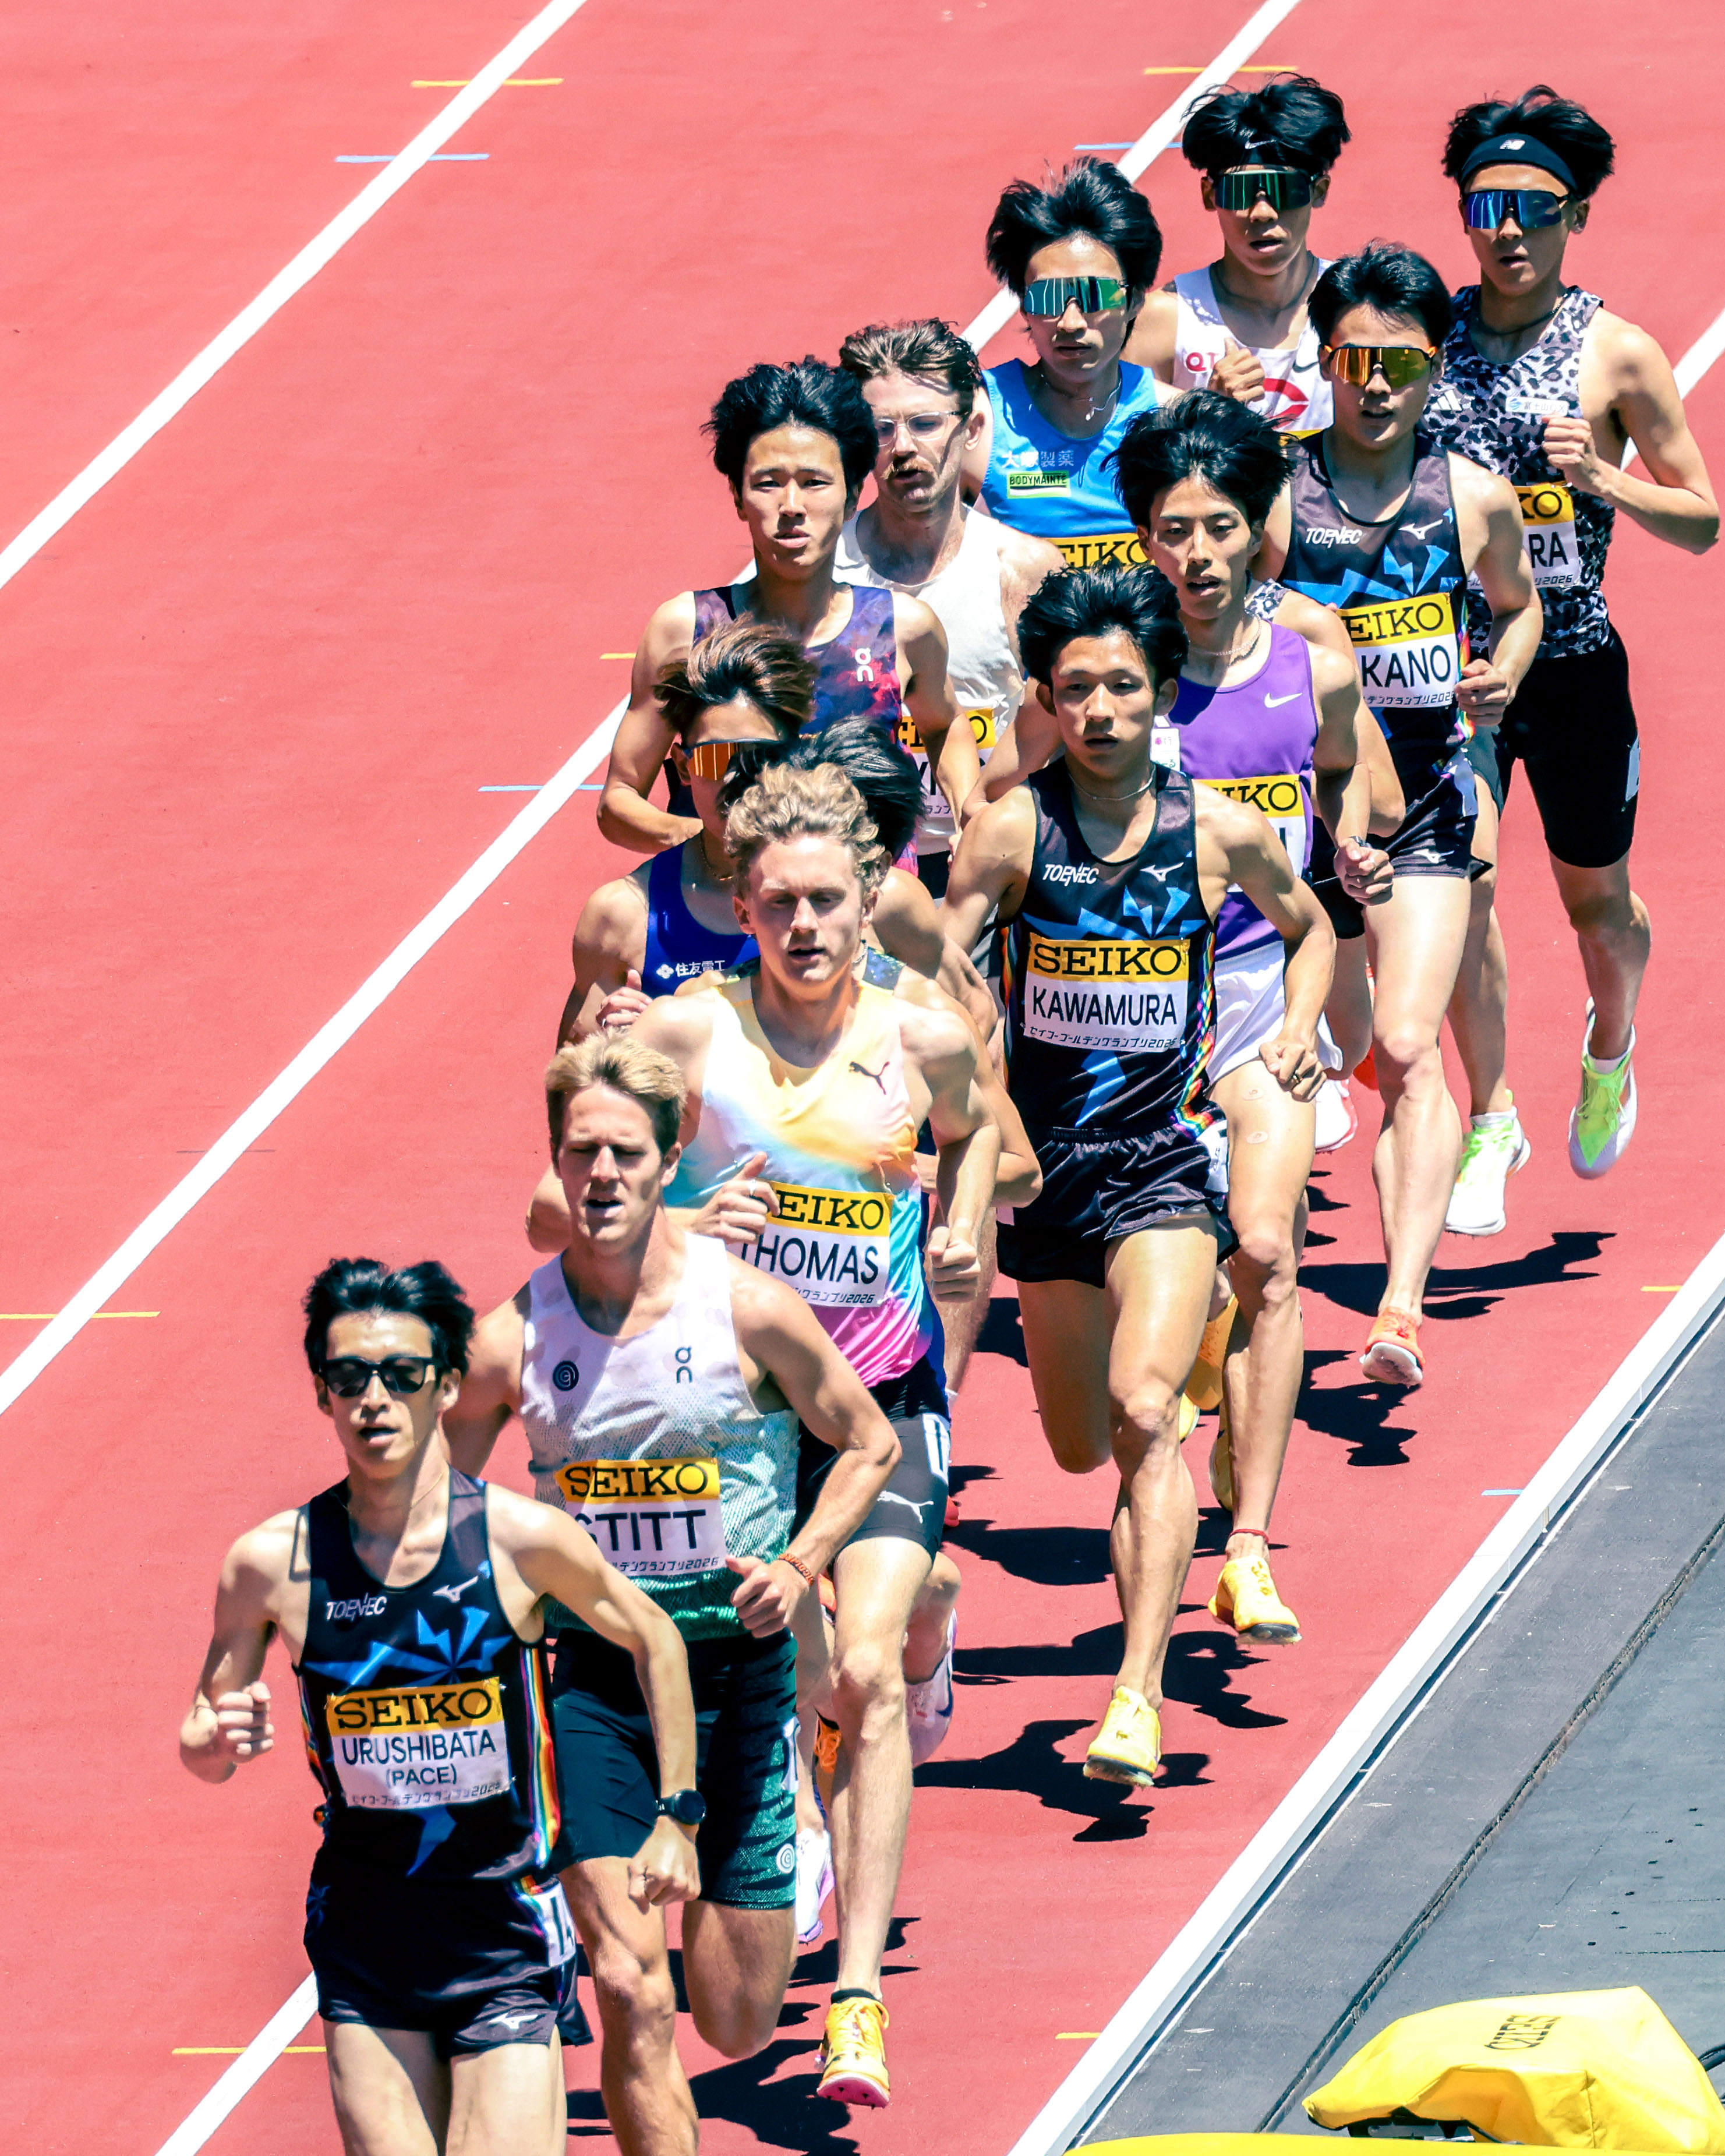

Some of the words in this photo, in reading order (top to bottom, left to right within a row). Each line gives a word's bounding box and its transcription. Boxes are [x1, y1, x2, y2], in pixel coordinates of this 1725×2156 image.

[1001, 450, 1074, 468] 大製薬
[1010, 473, 1067, 486] BODYMAINTE
[1305, 526, 1363, 549] TOENEC
[1361, 645, 1451, 688] KANO
[1042, 862, 1100, 886] TOENEC
[676, 960, 726, 977] 住友電工
[1033, 942, 1182, 975] SEIKO
[1033, 986, 1178, 1026] KAWAMURA
[772, 1189, 884, 1230] EIKO
[565, 1463, 708, 1497] SEIKO
[326, 1592, 387, 1621] TOENEC
[333, 1688, 492, 1729] SEIKO
[341, 1729, 496, 1765] URUSHIBATA
[386, 1765, 457, 1789] (PACE)
